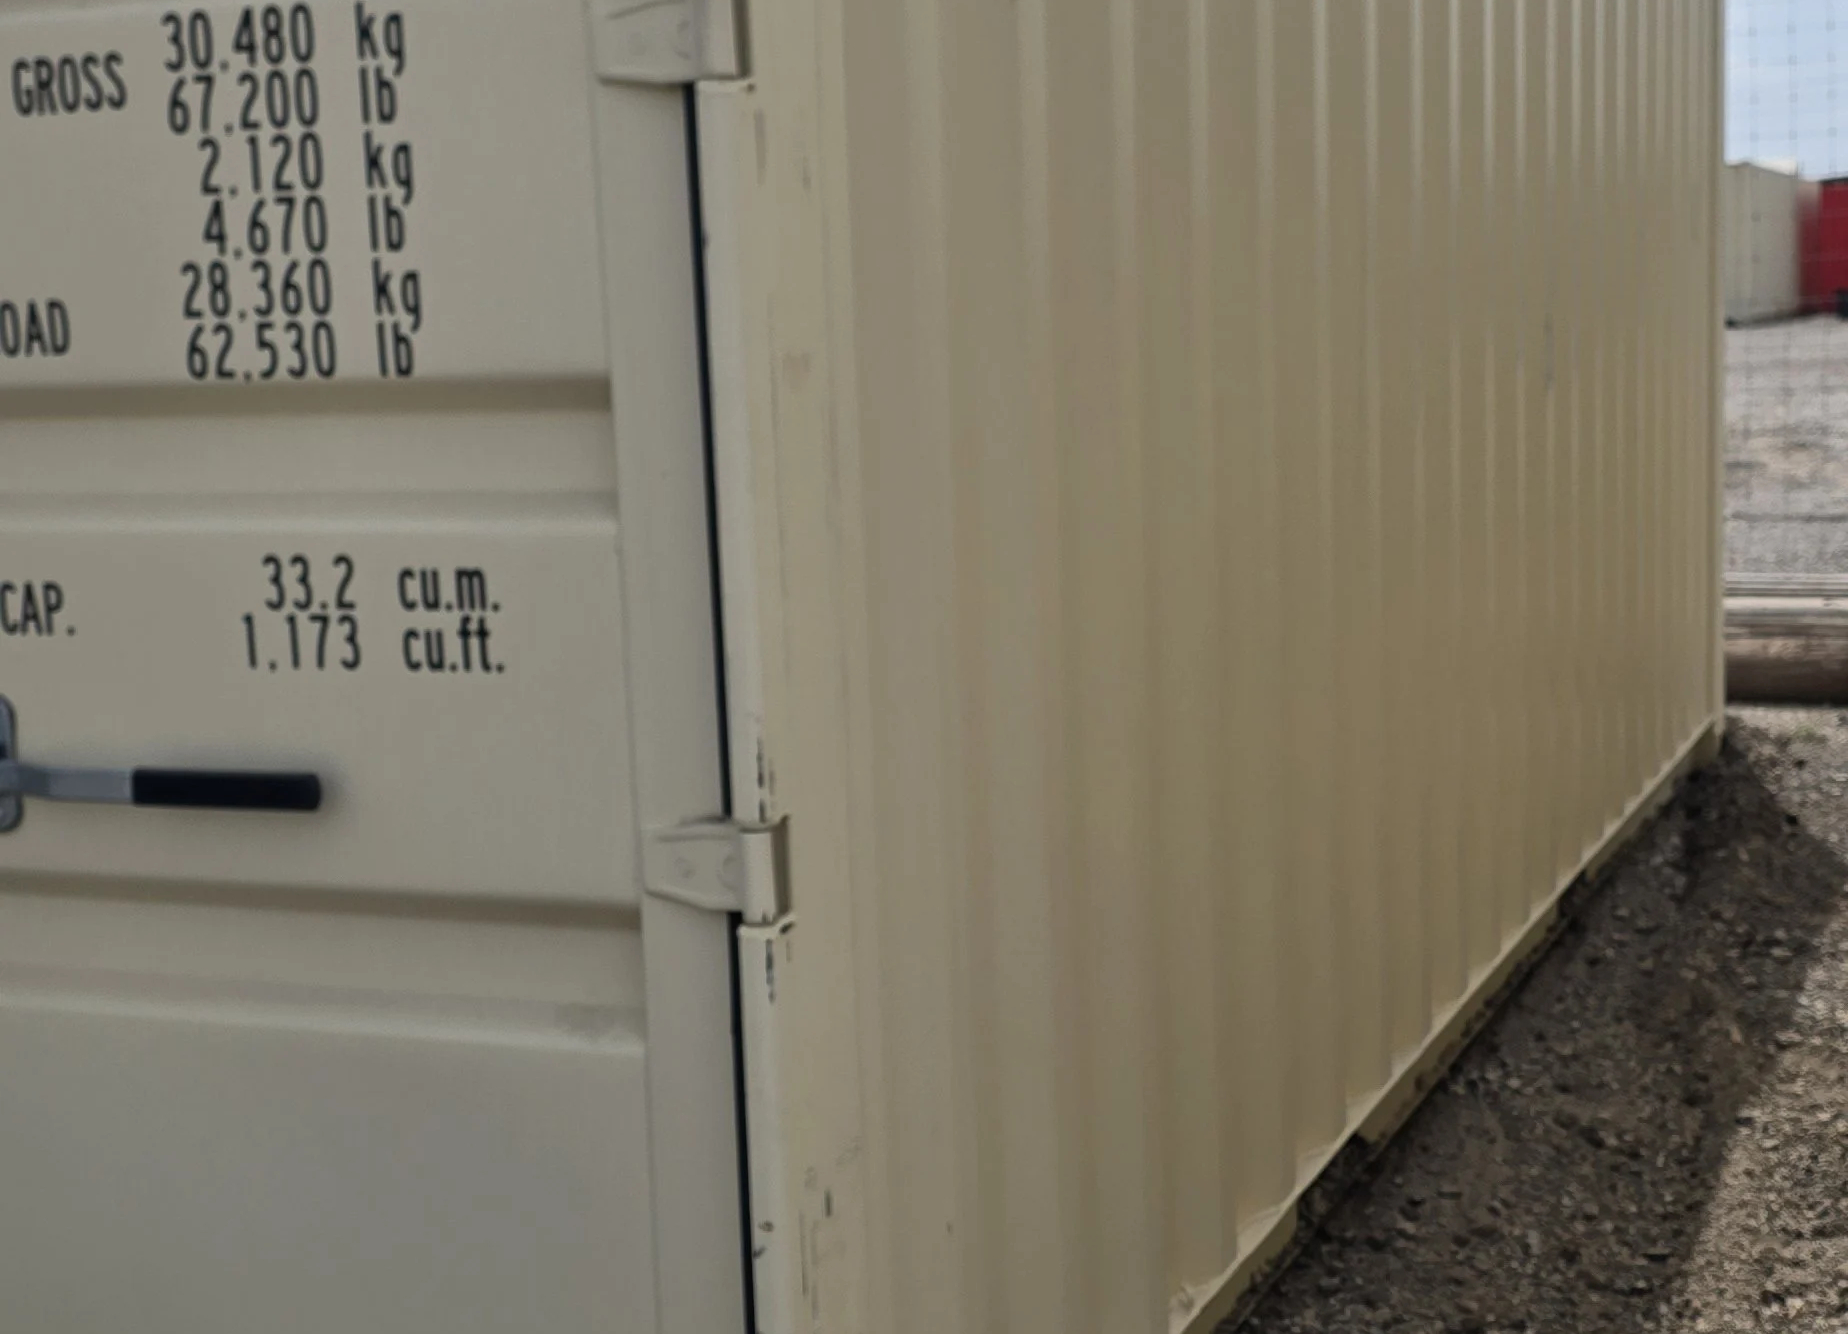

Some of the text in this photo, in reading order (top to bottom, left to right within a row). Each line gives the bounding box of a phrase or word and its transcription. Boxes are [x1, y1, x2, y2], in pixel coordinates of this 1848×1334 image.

[354, 0, 406, 77] kg
[11, 50, 128, 117] GROSS
[358, 65, 398, 125] lb
[363, 129, 414, 205] kg
[367, 194, 406, 253] lb
[371, 256, 422, 334] kg
[376, 320, 415, 379] lb
[0, 580, 76, 638] CAP.
[262, 553, 501, 613] 33.2 cu.m.
[402, 615, 505, 674] cu.ft.
